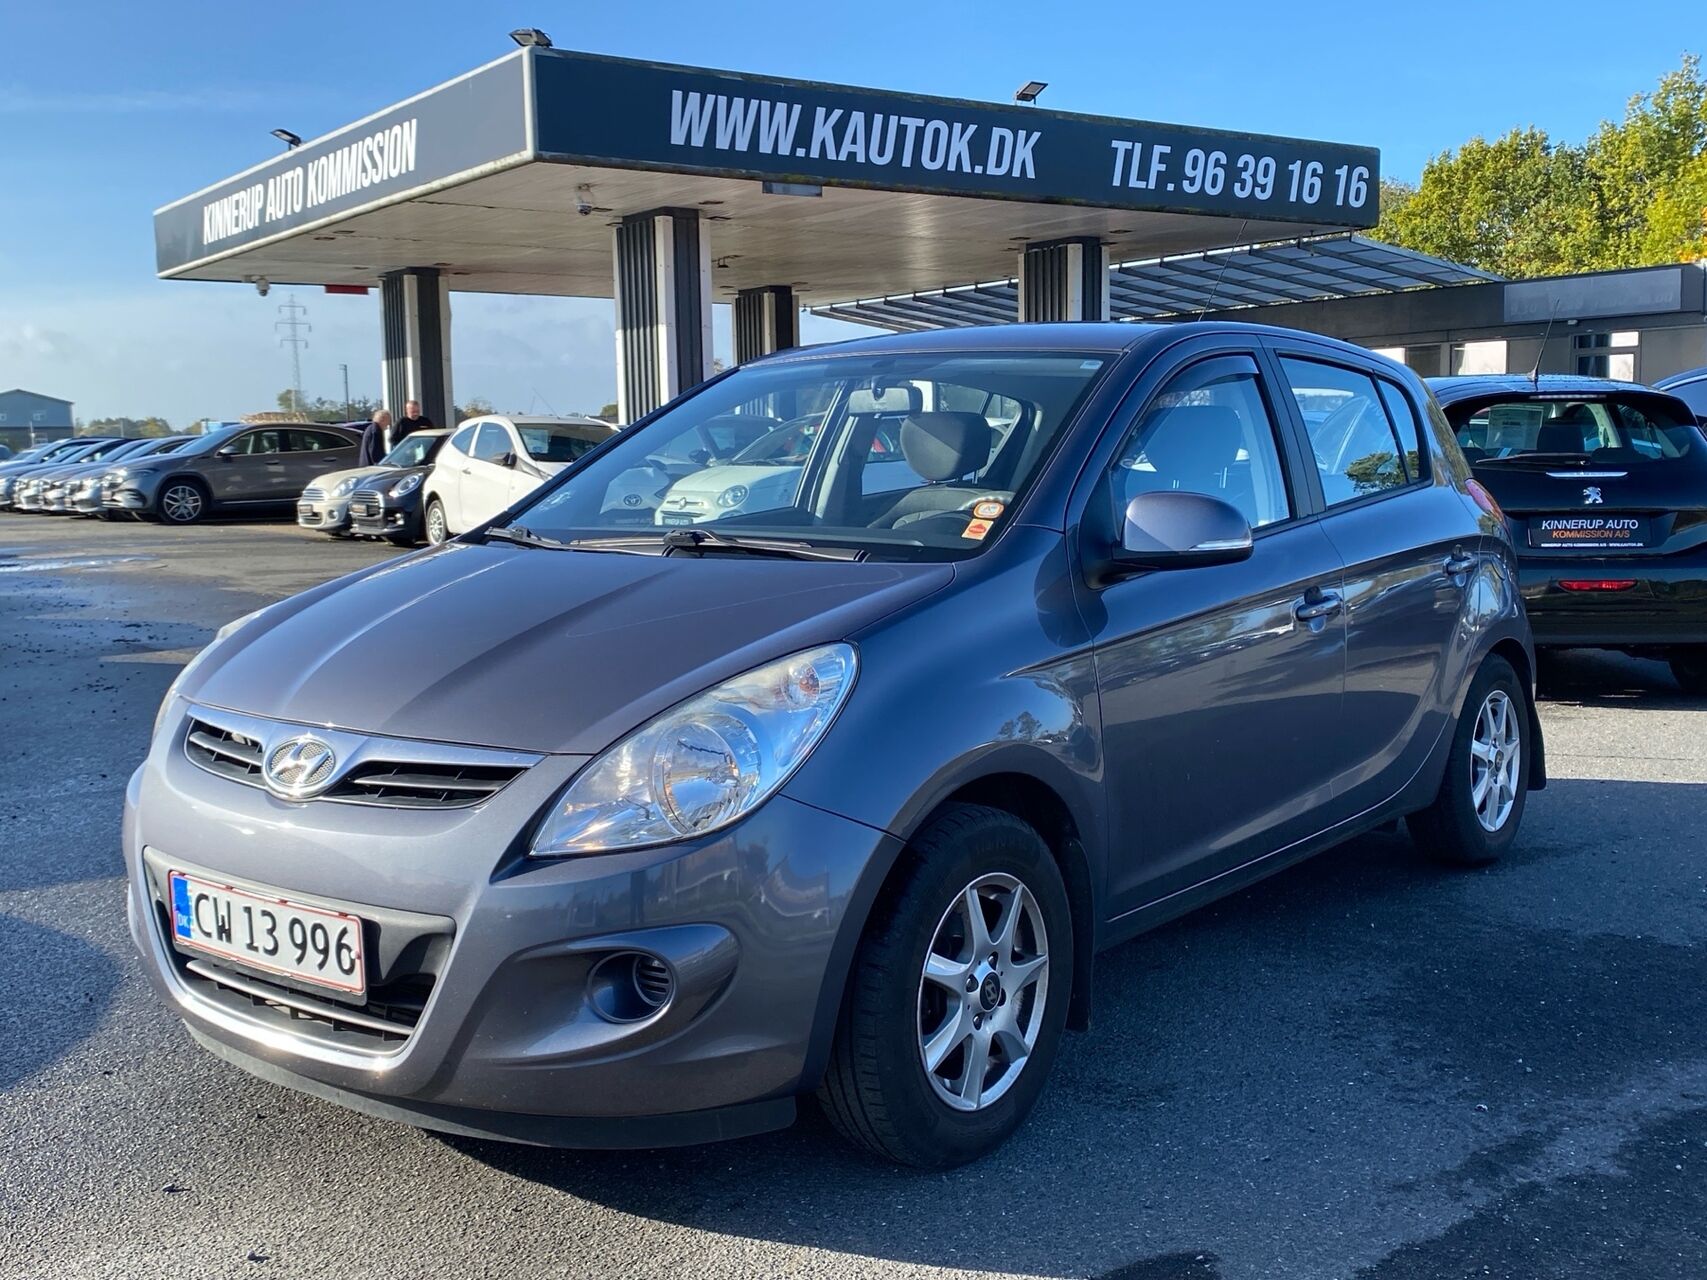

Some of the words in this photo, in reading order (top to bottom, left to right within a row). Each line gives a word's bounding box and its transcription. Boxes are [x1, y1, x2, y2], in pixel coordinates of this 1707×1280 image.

[670, 89, 1042, 179] WWW.KAUTOK.DK
[203, 184, 264, 245] KINNERUP
[265, 167, 304, 222] AUTO
[306, 118, 418, 209] KOMMISSION
[1111, 140, 1175, 191] TLF.
[1182, 148, 1227, 196] 96
[1233, 153, 1277, 200] 39
[1288, 159, 1324, 205] 16
[1334, 164, 1370, 208] 16
[1541, 519, 1604, 530] KINNERUP
[1605, 519, 1639, 530] AUTO
[1552, 530, 1614, 539] KOMMISSION
[1614, 530, 1631, 539] A/S
[194, 893, 233, 944] CW
[243, 906, 279, 957] 13
[288, 917, 356, 976] 996
